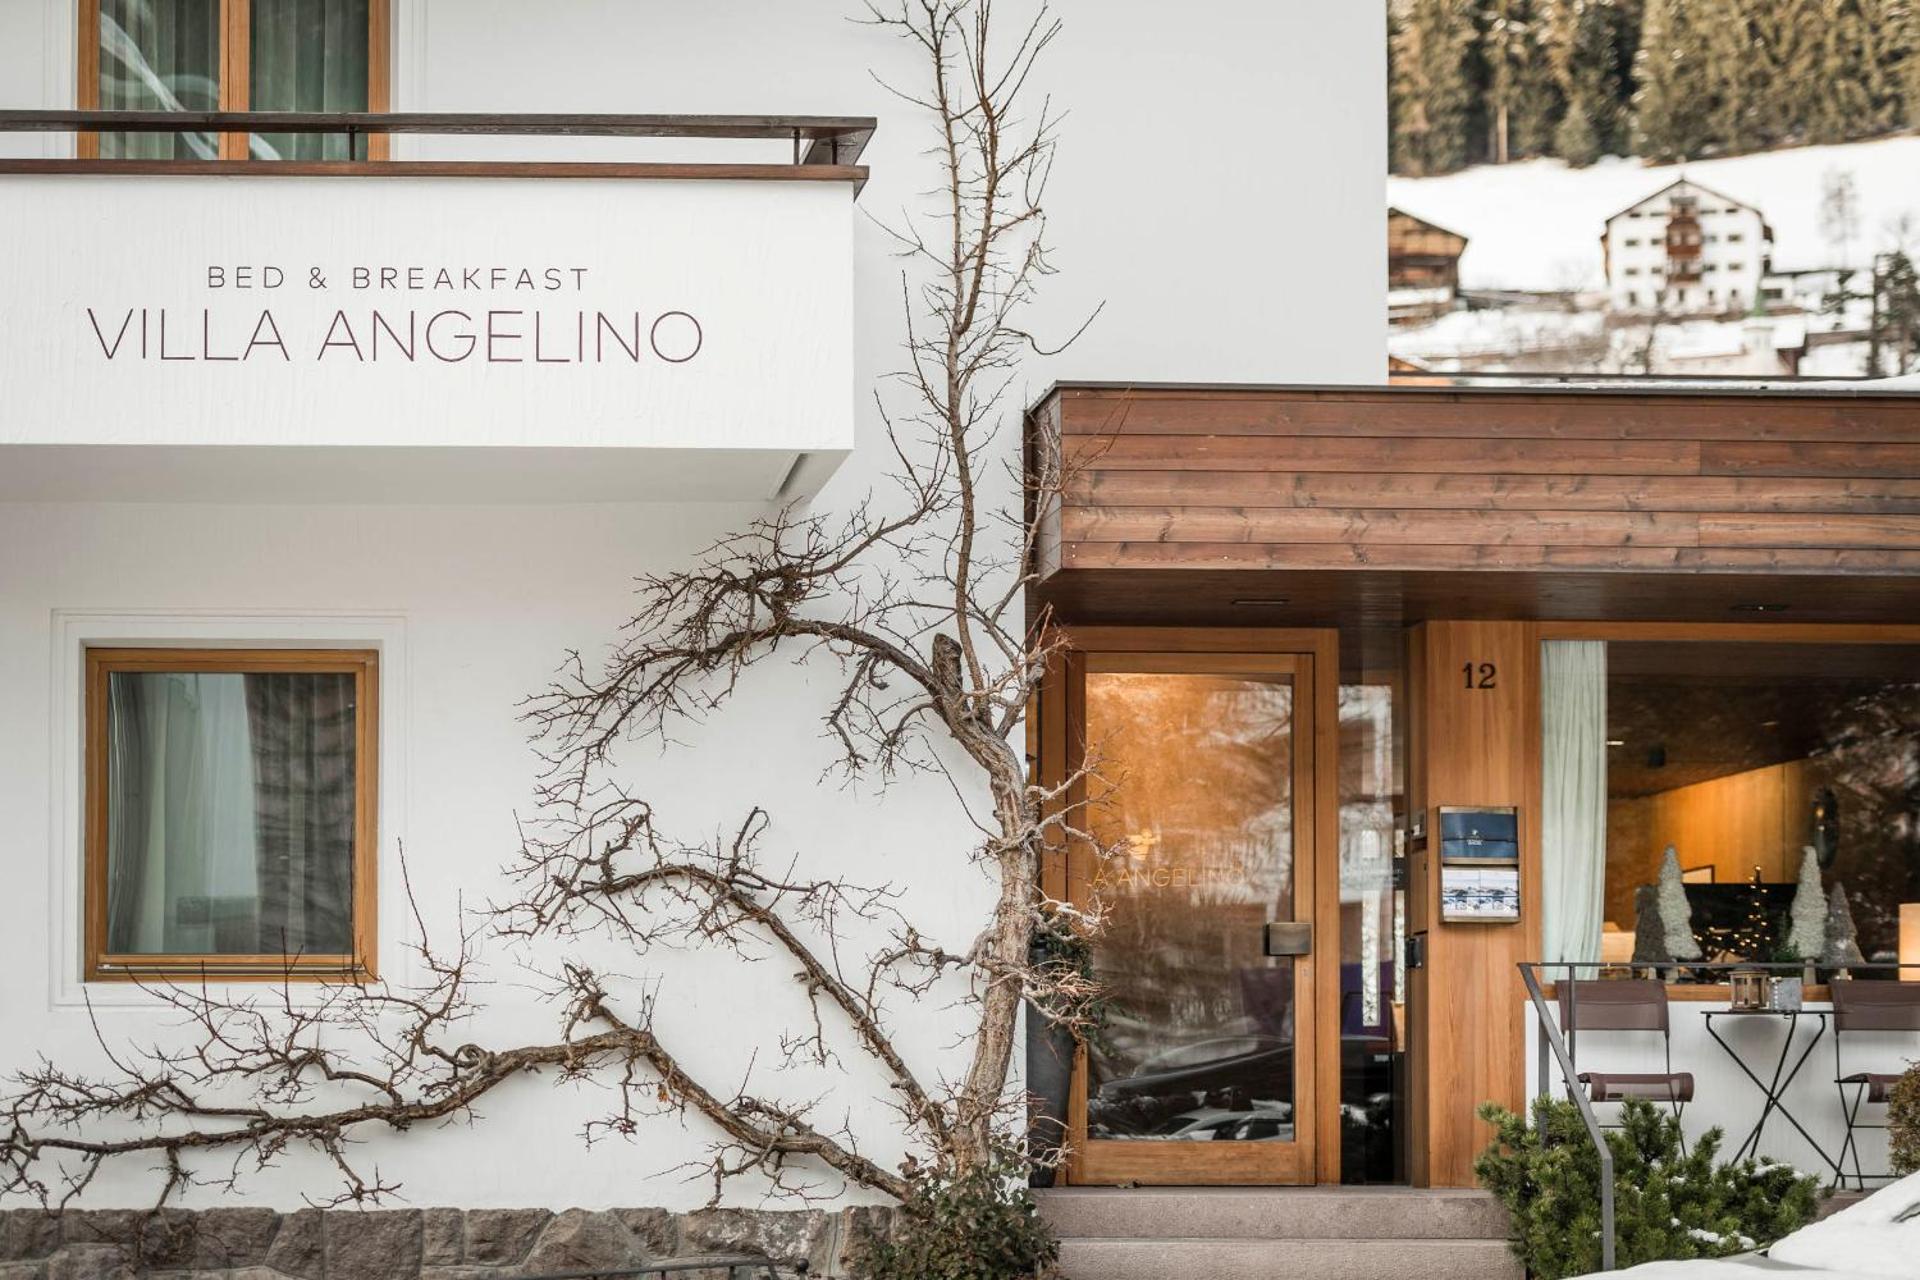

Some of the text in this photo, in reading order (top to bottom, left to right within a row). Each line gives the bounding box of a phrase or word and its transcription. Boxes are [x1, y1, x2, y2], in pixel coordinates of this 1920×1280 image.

[207, 265, 589, 291] BED & BREAKFAST
[86, 307, 703, 364] VILLA ANGELINO
[1462, 662, 1496, 689] 12
[1117, 867, 1245, 887] ANGELINO
